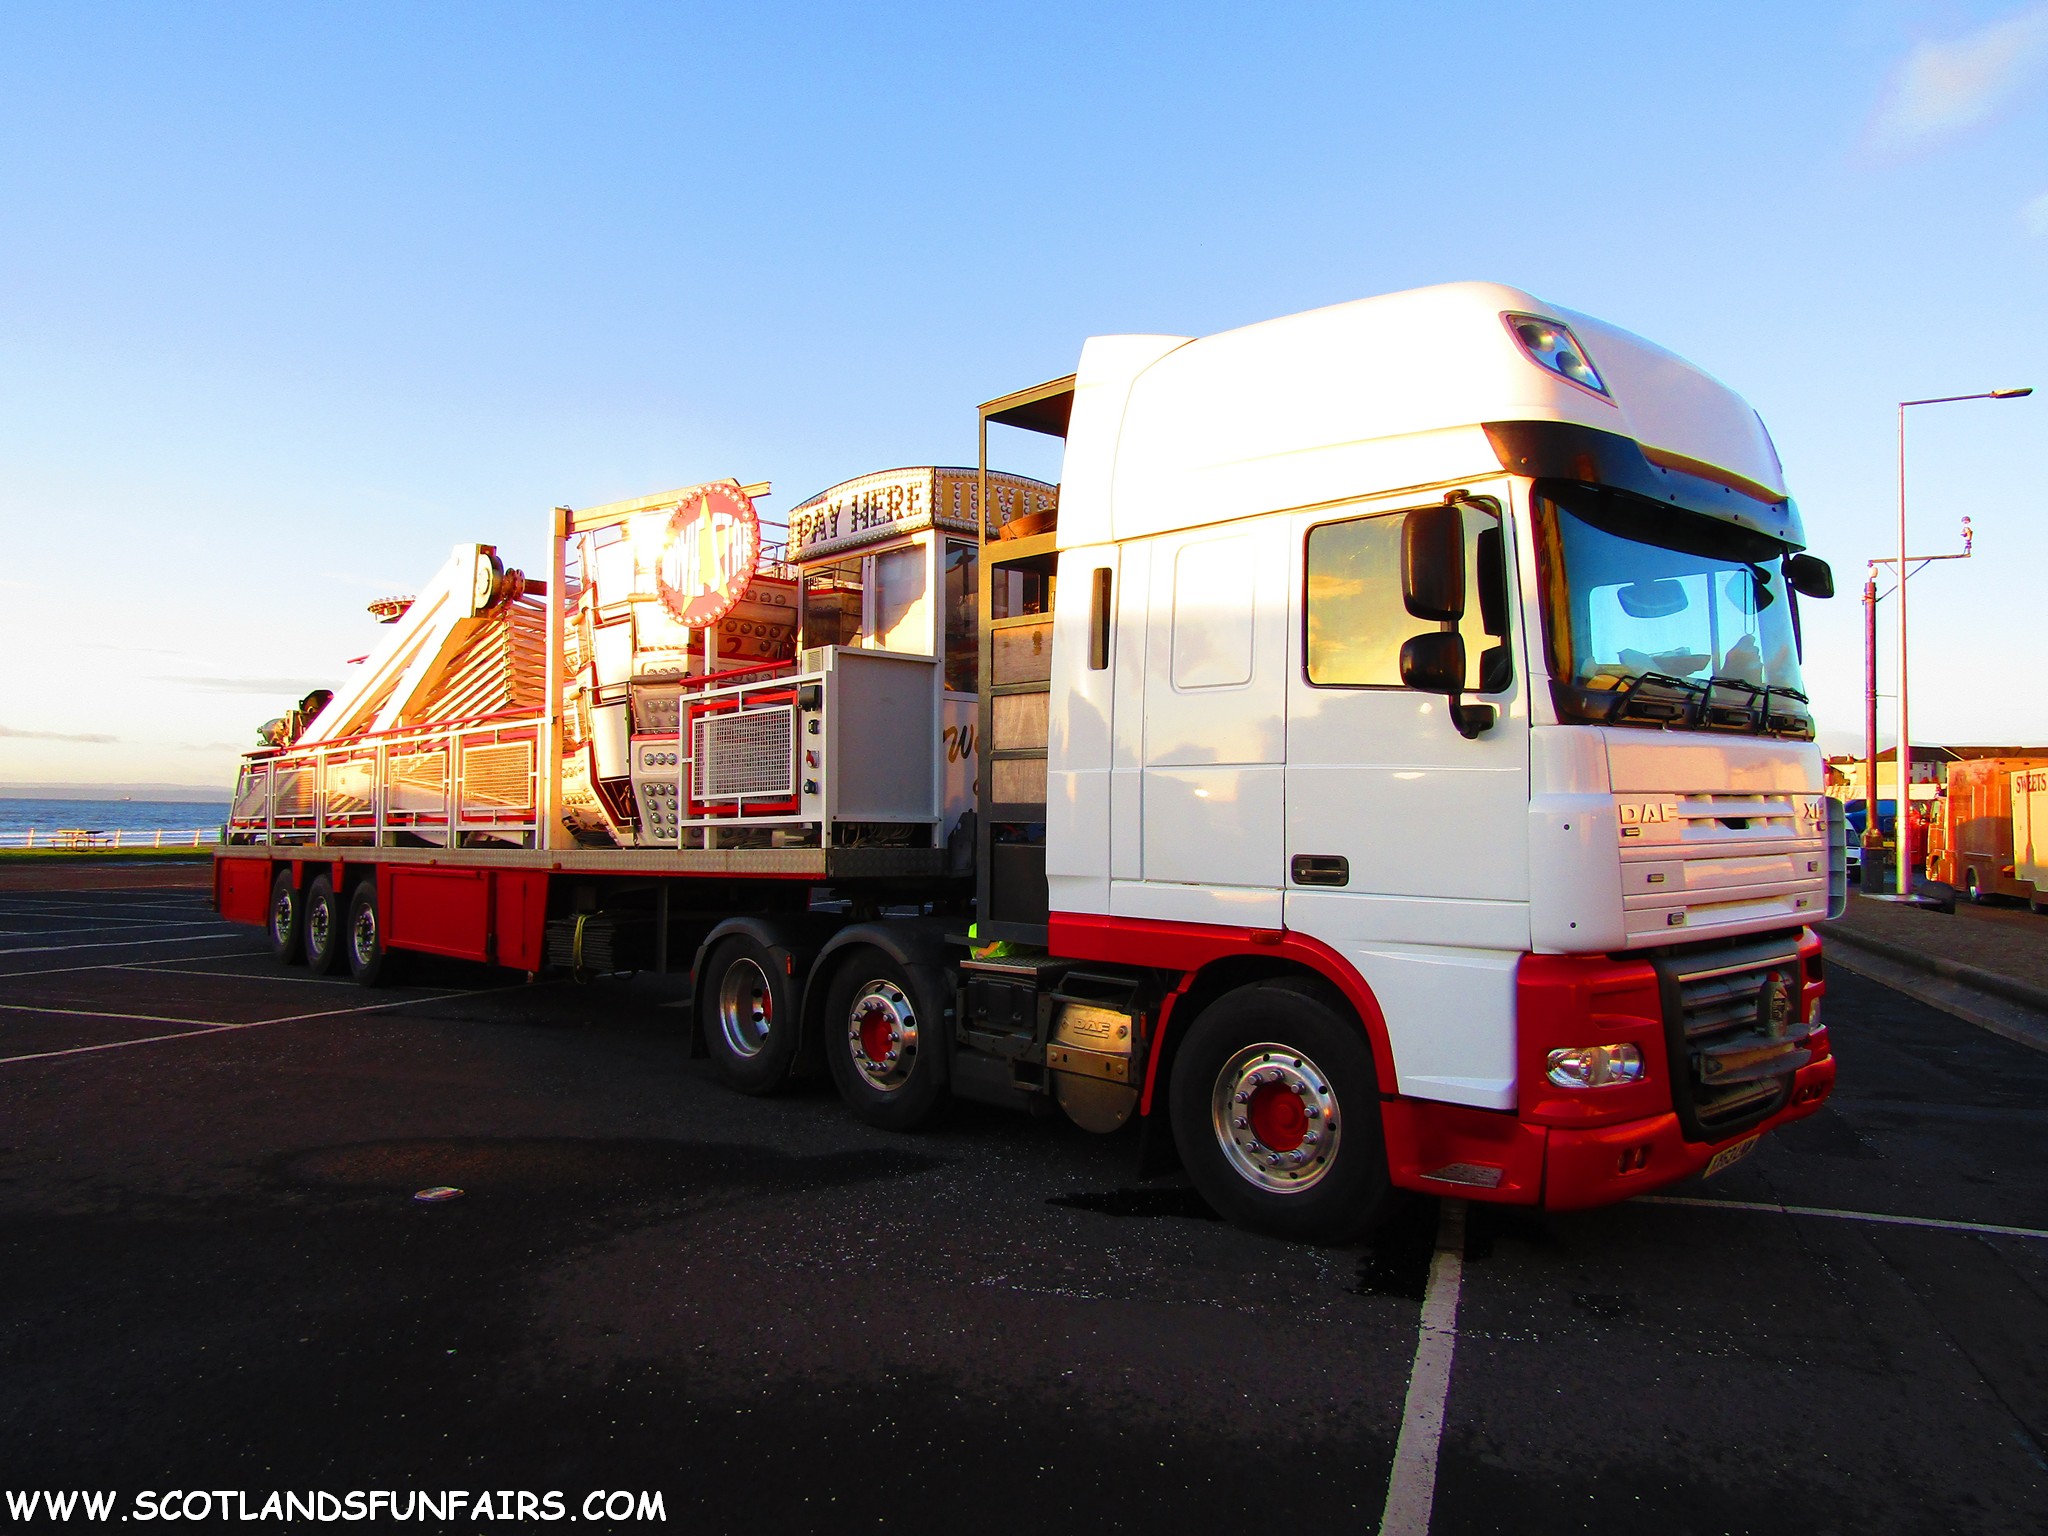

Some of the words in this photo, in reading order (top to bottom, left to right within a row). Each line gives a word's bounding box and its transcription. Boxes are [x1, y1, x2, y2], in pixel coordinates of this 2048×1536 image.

[796, 499, 843, 547] PAY
[850, 481, 923, 532] HERE
[709, 512, 752, 593] STAR
[2016, 772, 2047, 794] SWEETS
[1619, 803, 1679, 824] DAF
[1073, 1018, 1111, 1033] DAF
